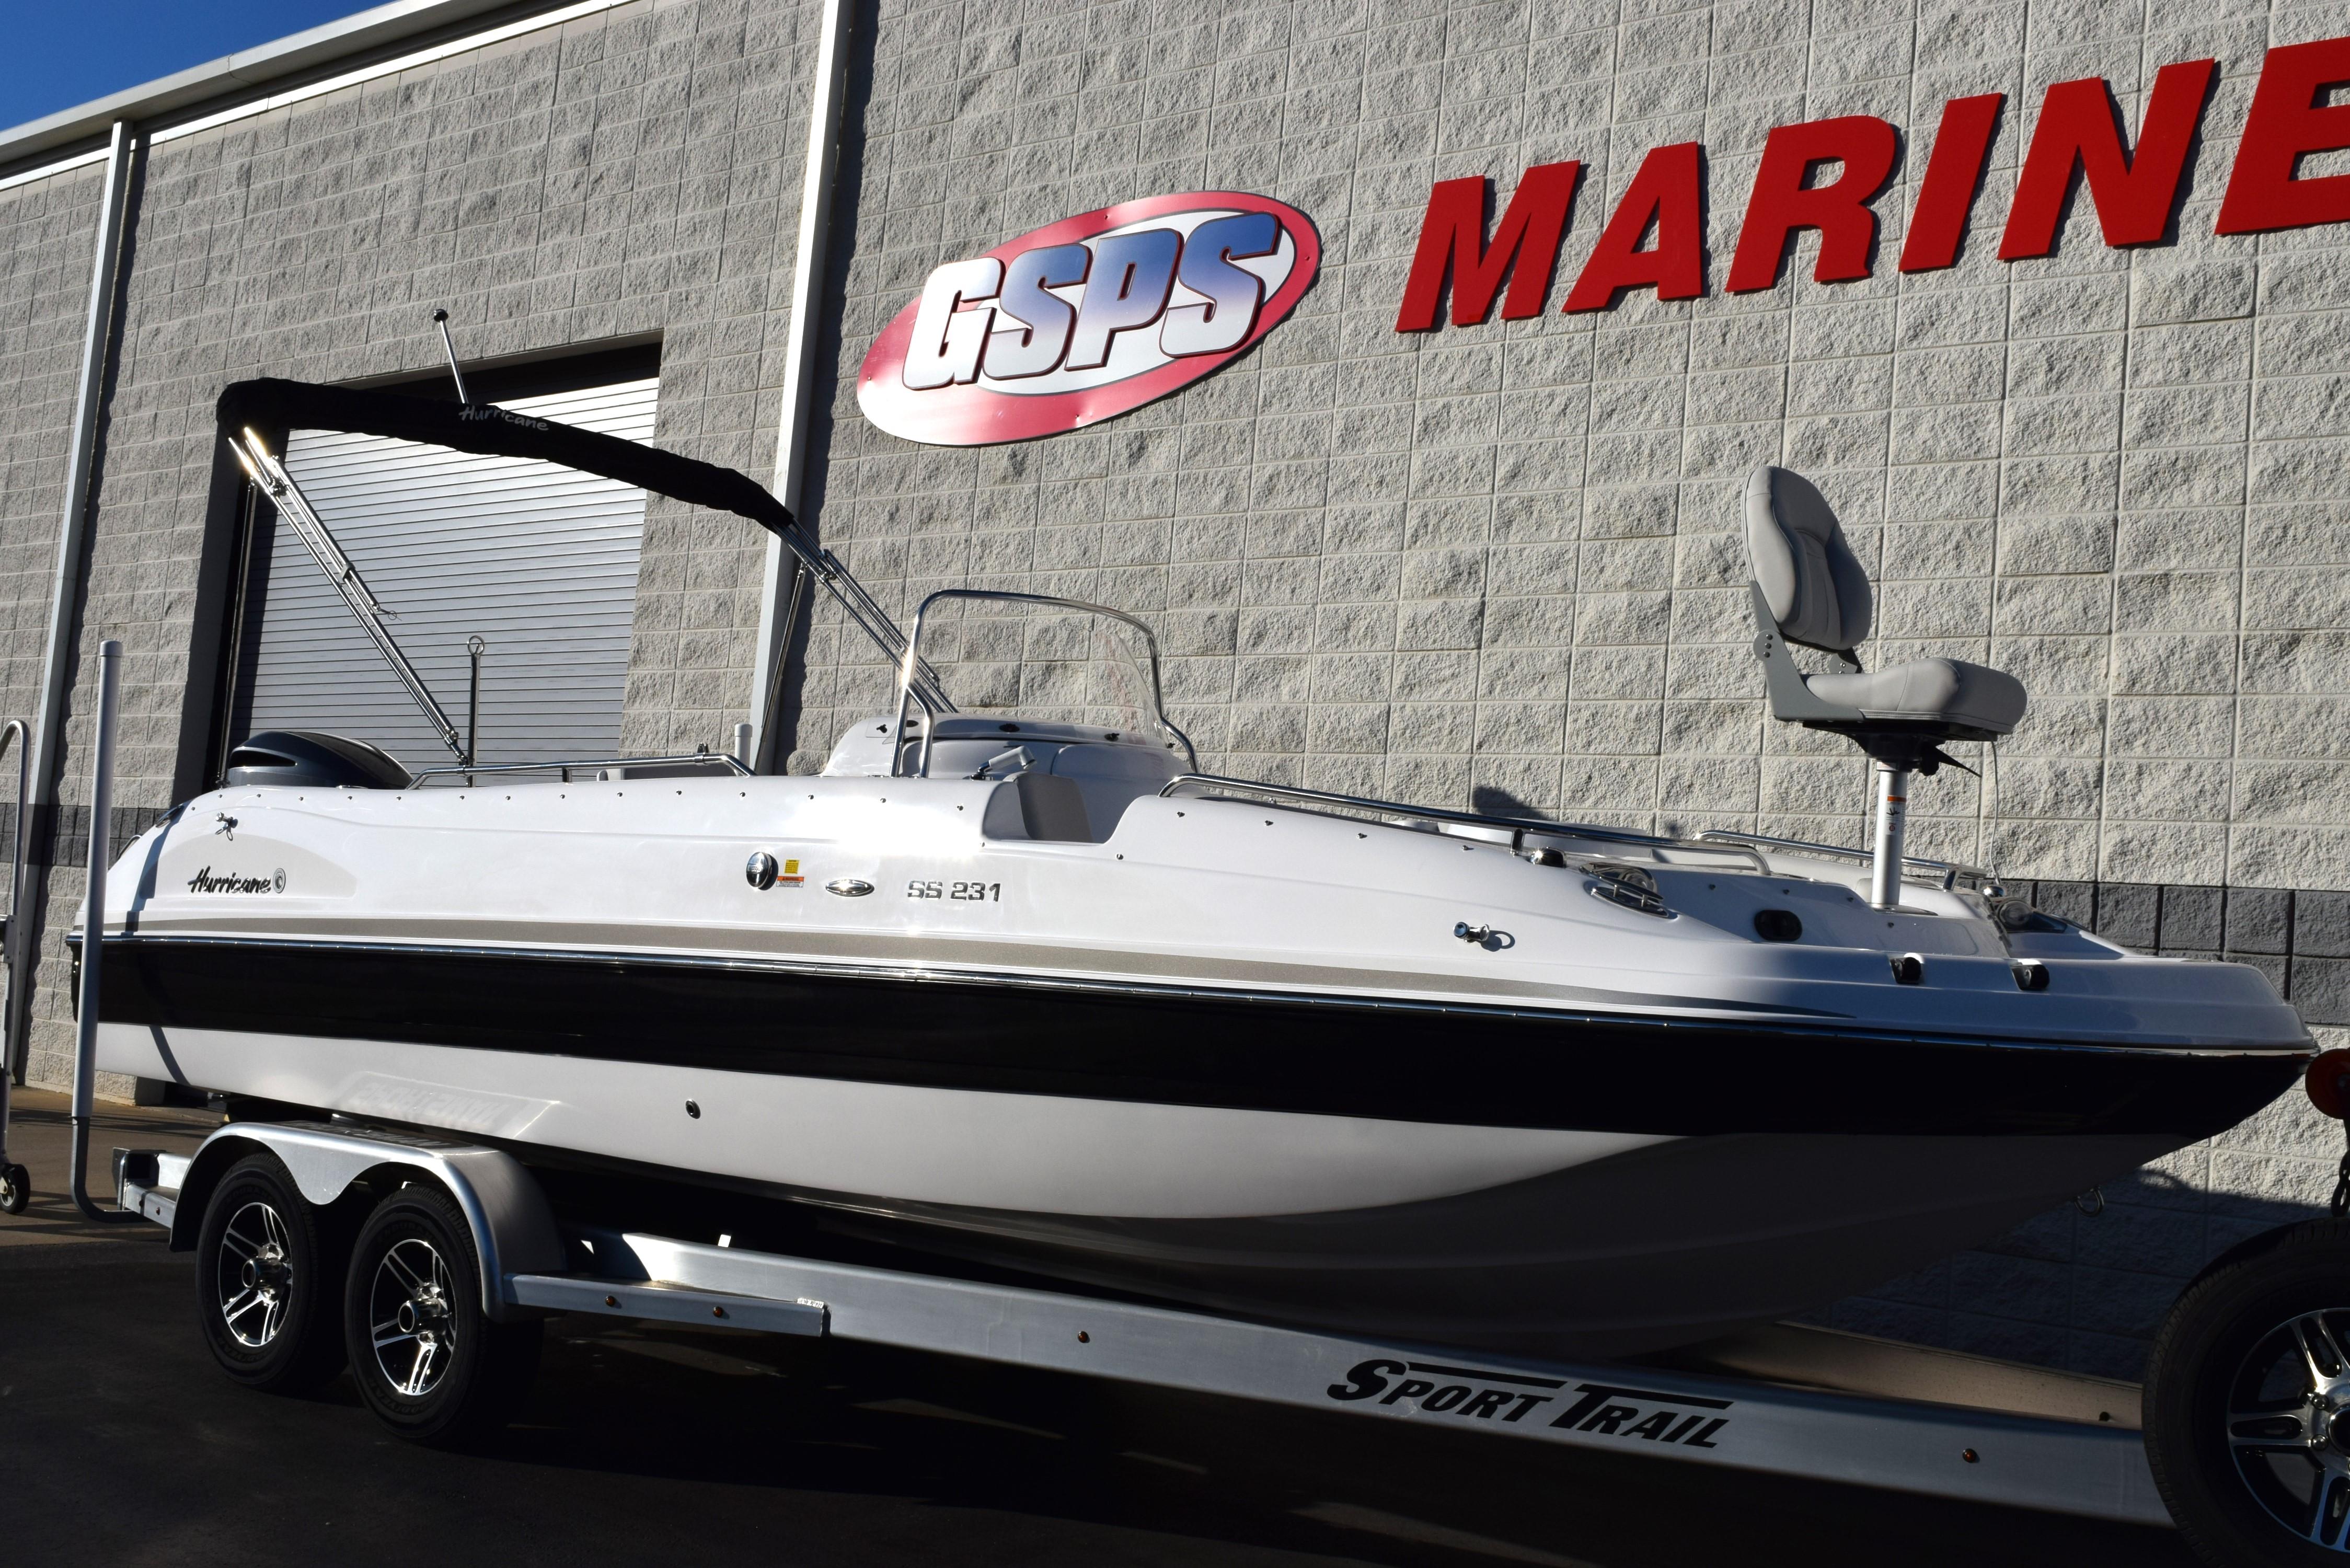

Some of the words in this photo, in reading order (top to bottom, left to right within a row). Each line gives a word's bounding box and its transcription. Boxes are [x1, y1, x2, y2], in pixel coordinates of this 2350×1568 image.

[1395, 36, 2350, 333] MARINE
[902, 211, 1280, 391] GSPS
[458, 405, 549, 431] Hurricane
[187, 865, 271, 894] Hurricane
[907, 880, 943, 900] SS
[949, 881, 1001, 902] 231
[1327, 1358, 1555, 1422] SPORT
[1549, 1383, 1735, 1448] TRAIL
